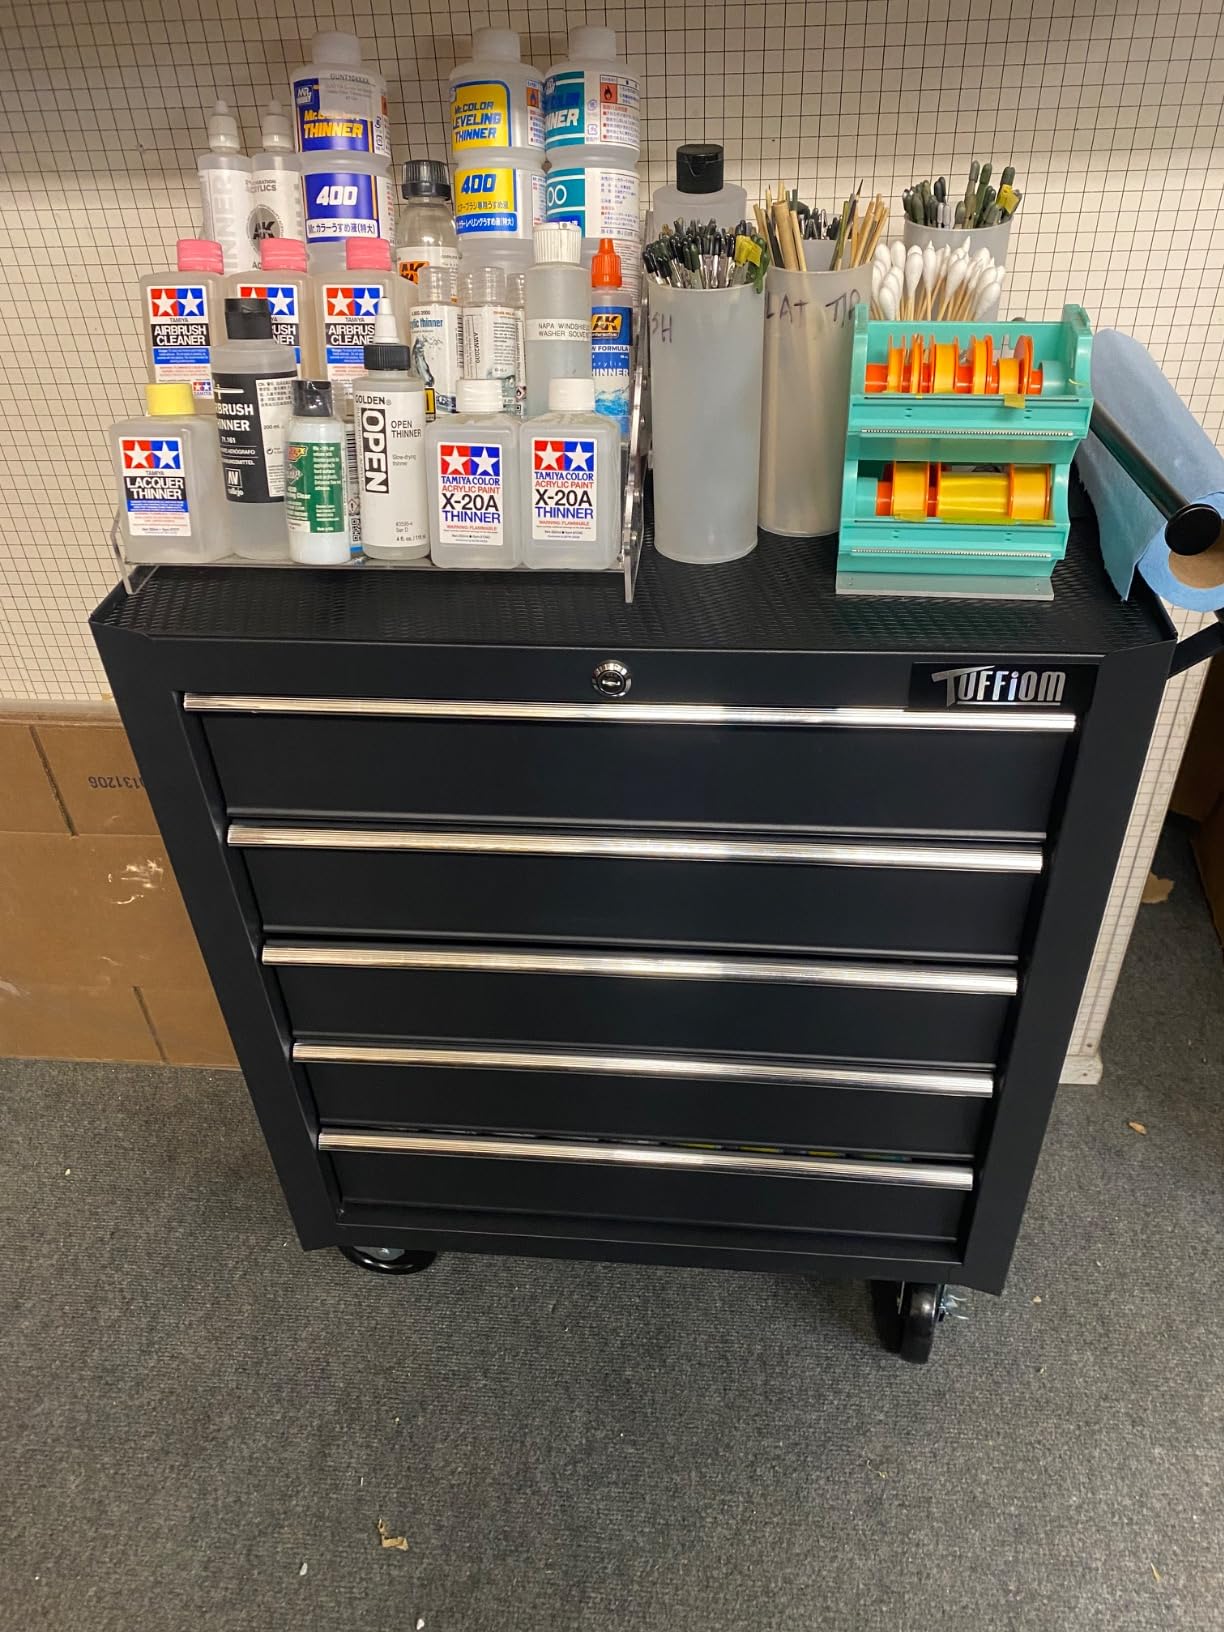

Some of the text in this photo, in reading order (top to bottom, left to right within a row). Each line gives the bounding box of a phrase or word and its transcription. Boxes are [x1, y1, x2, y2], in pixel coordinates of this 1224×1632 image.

[453, 113, 502, 129] LEVELING
[304, 122, 364, 138] THINNER
[456, 128, 497, 143] THINNER
[461, 174, 496, 194] 400
[316, 186, 358, 206] 400
[420, 318, 443, 328] thinner
[593, 315, 618, 331] AK
[154, 325, 206, 335] AIRBRUSH
[271, 325, 296, 335] USH
[156, 335, 206, 346] CLEANER
[391, 430, 422, 438] THINNER
[363, 410, 388, 492] OPEN
[441, 476, 500, 486] TAMIYA COLOR
[534, 472, 594, 481] TAMIYA COLOR
[126, 477, 184, 489] LACQUER
[535, 480, 569, 488] ACRYLIC
[130, 488, 182, 500] THINNER
[442, 485, 501, 495] ACRYLIC PAINT
[441, 493, 500, 511] X-20A
[535, 489, 593, 507] X-20A
[442, 511, 501, 523] THINNER
[535, 507, 594, 519] THINNER
[88, 776, 144, 789] 131206
